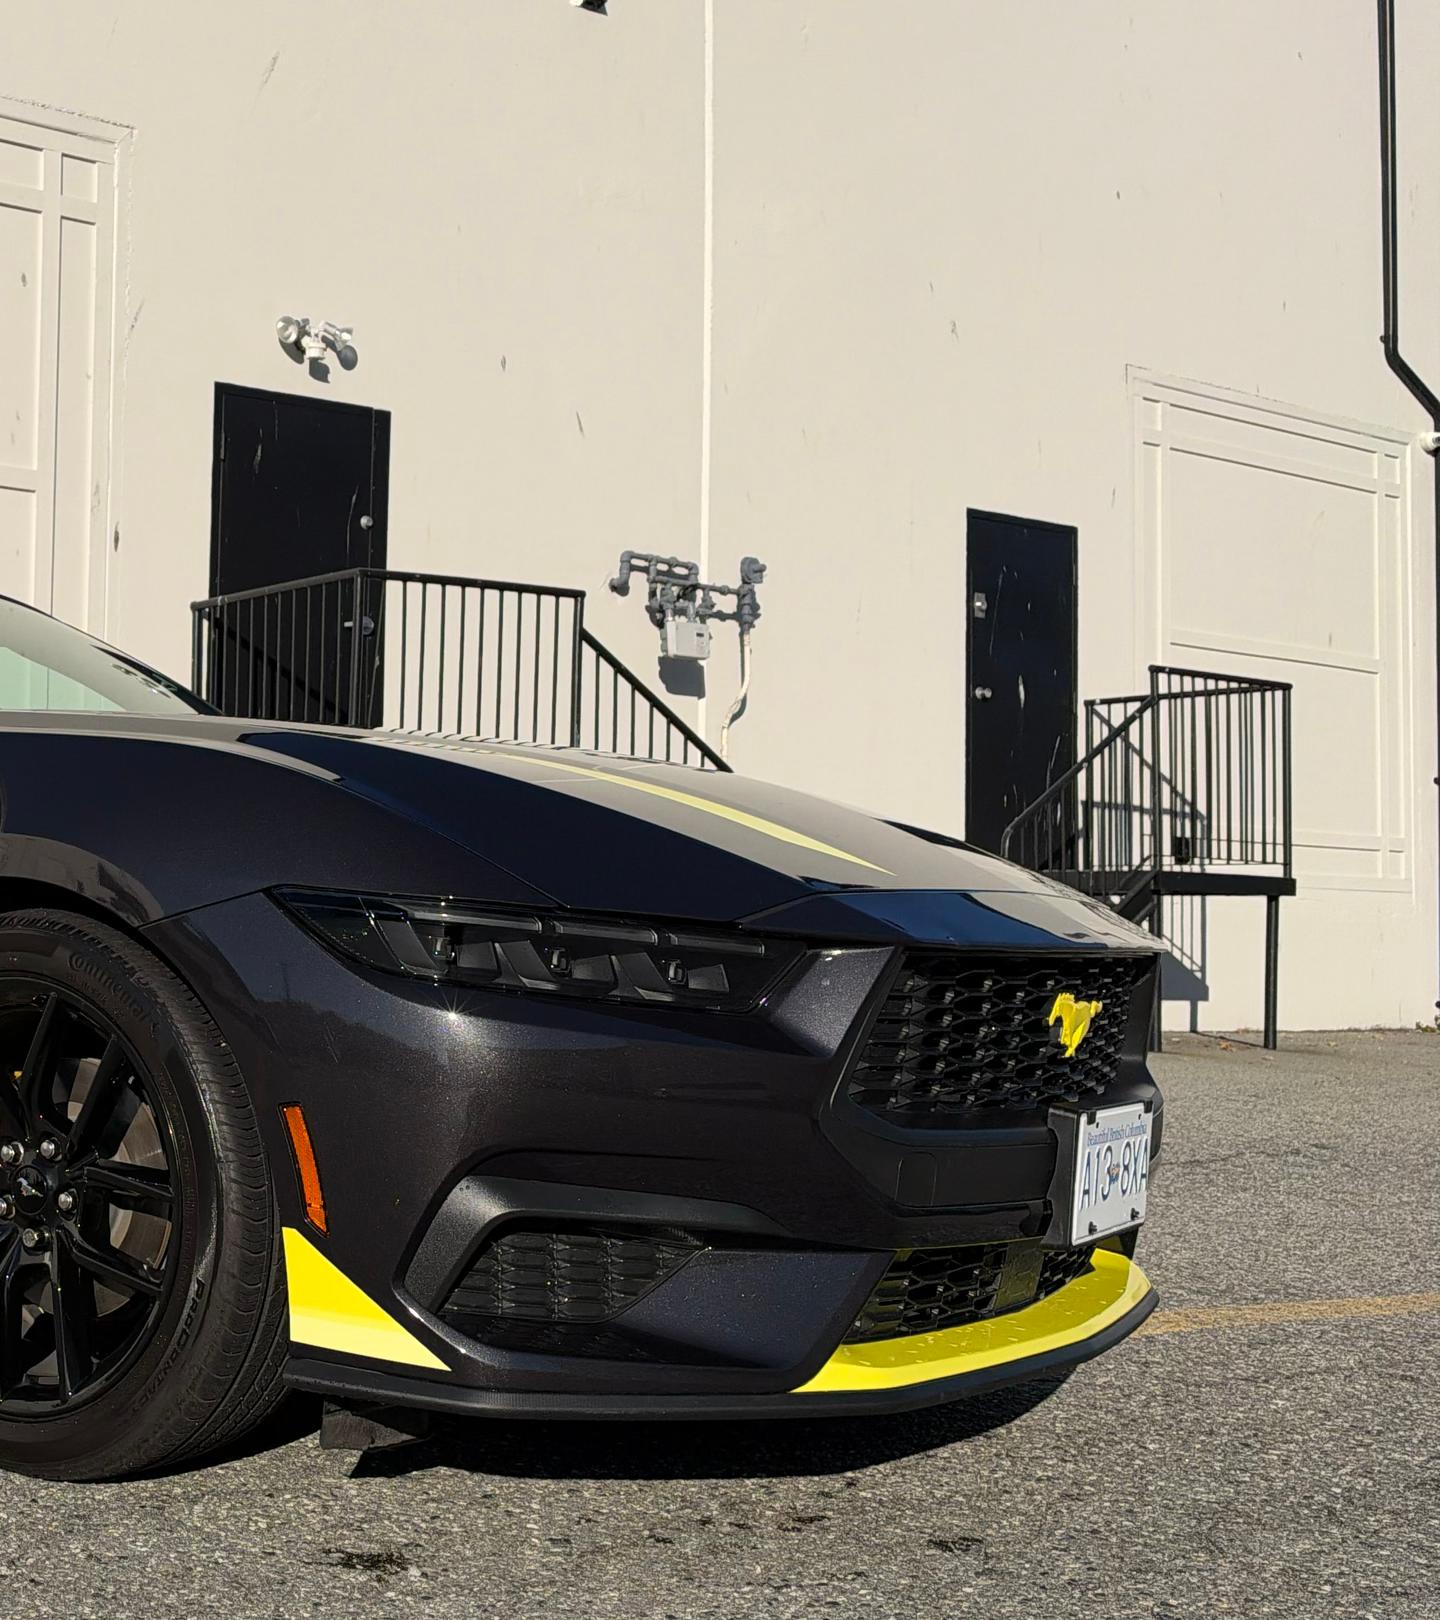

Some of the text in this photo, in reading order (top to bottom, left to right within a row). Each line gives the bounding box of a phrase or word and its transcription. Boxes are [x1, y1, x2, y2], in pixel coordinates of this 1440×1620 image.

[1087, 1121, 1148, 1146] Beautiful British Columbia
